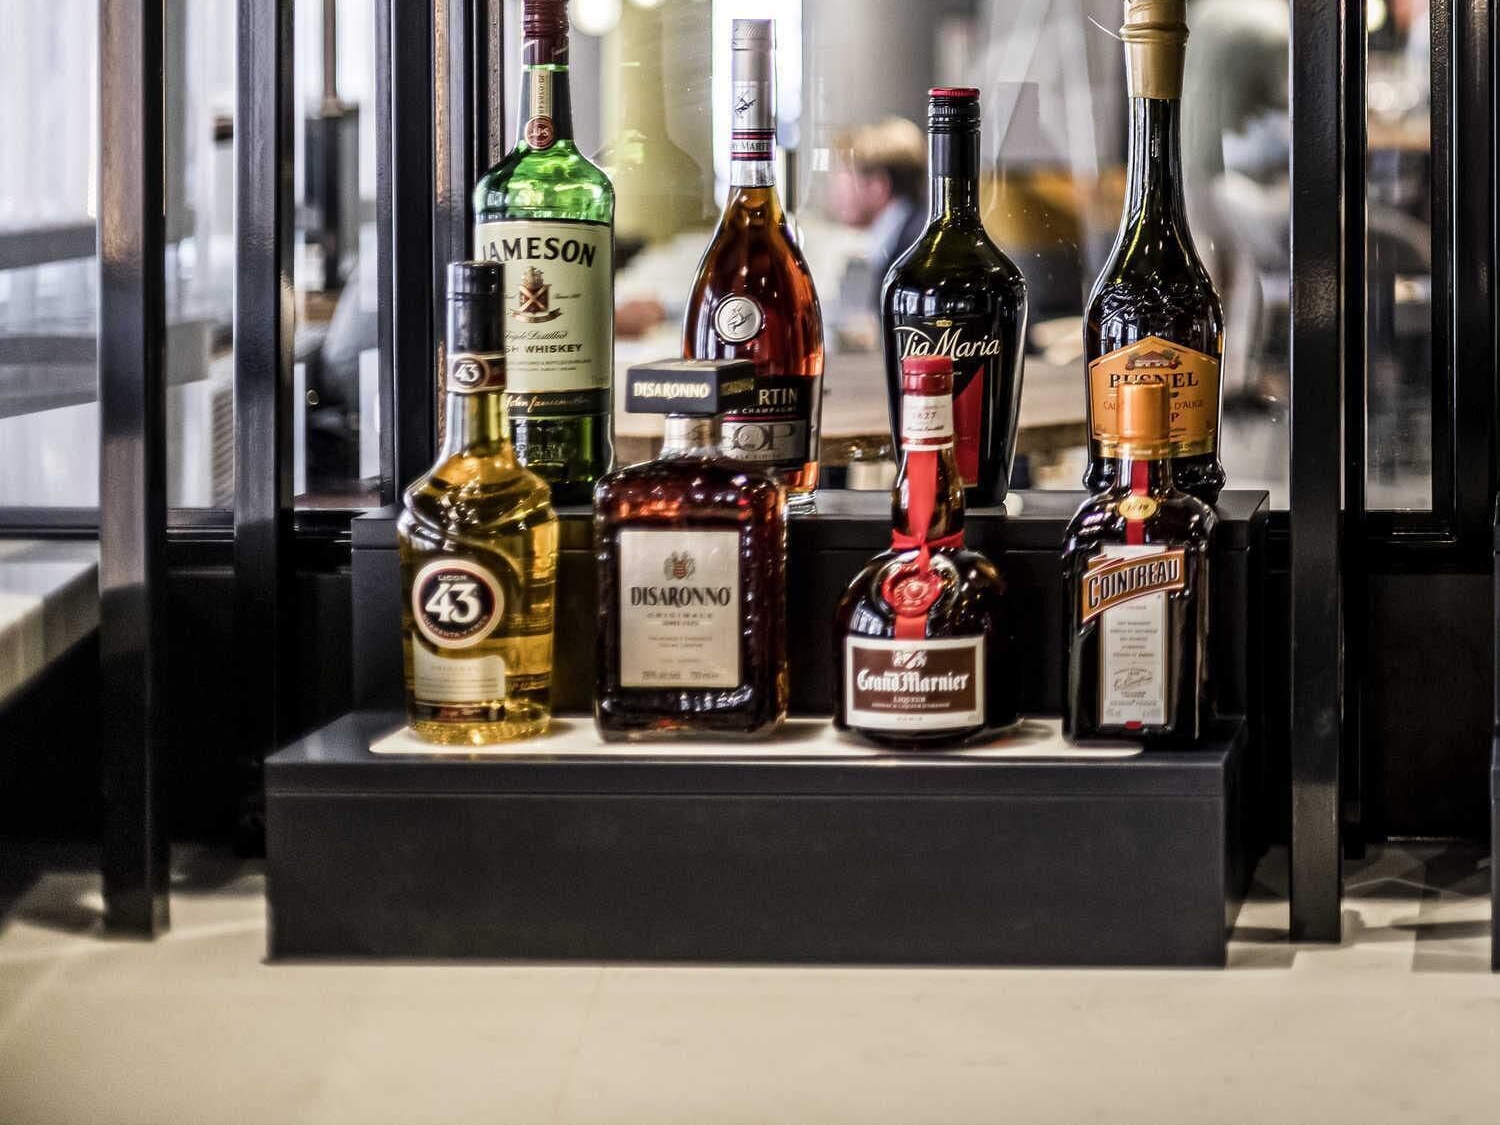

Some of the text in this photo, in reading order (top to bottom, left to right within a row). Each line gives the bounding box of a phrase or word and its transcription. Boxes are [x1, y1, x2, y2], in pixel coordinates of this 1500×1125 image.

[483, 237, 596, 267] JAMESON
[526, 344, 583, 353] WHISKEY
[930, 328, 1001, 361] Maria
[455, 363, 480, 382] 43
[633, 382, 711, 399] DISARONNO
[759, 388, 798, 405] RTIN
[1088, 558, 1180, 610] COINTREAU
[425, 583, 481, 623] 43
[631, 586, 731, 608] DISARONNO
[857, 668, 970, 693] Grand Marnier
